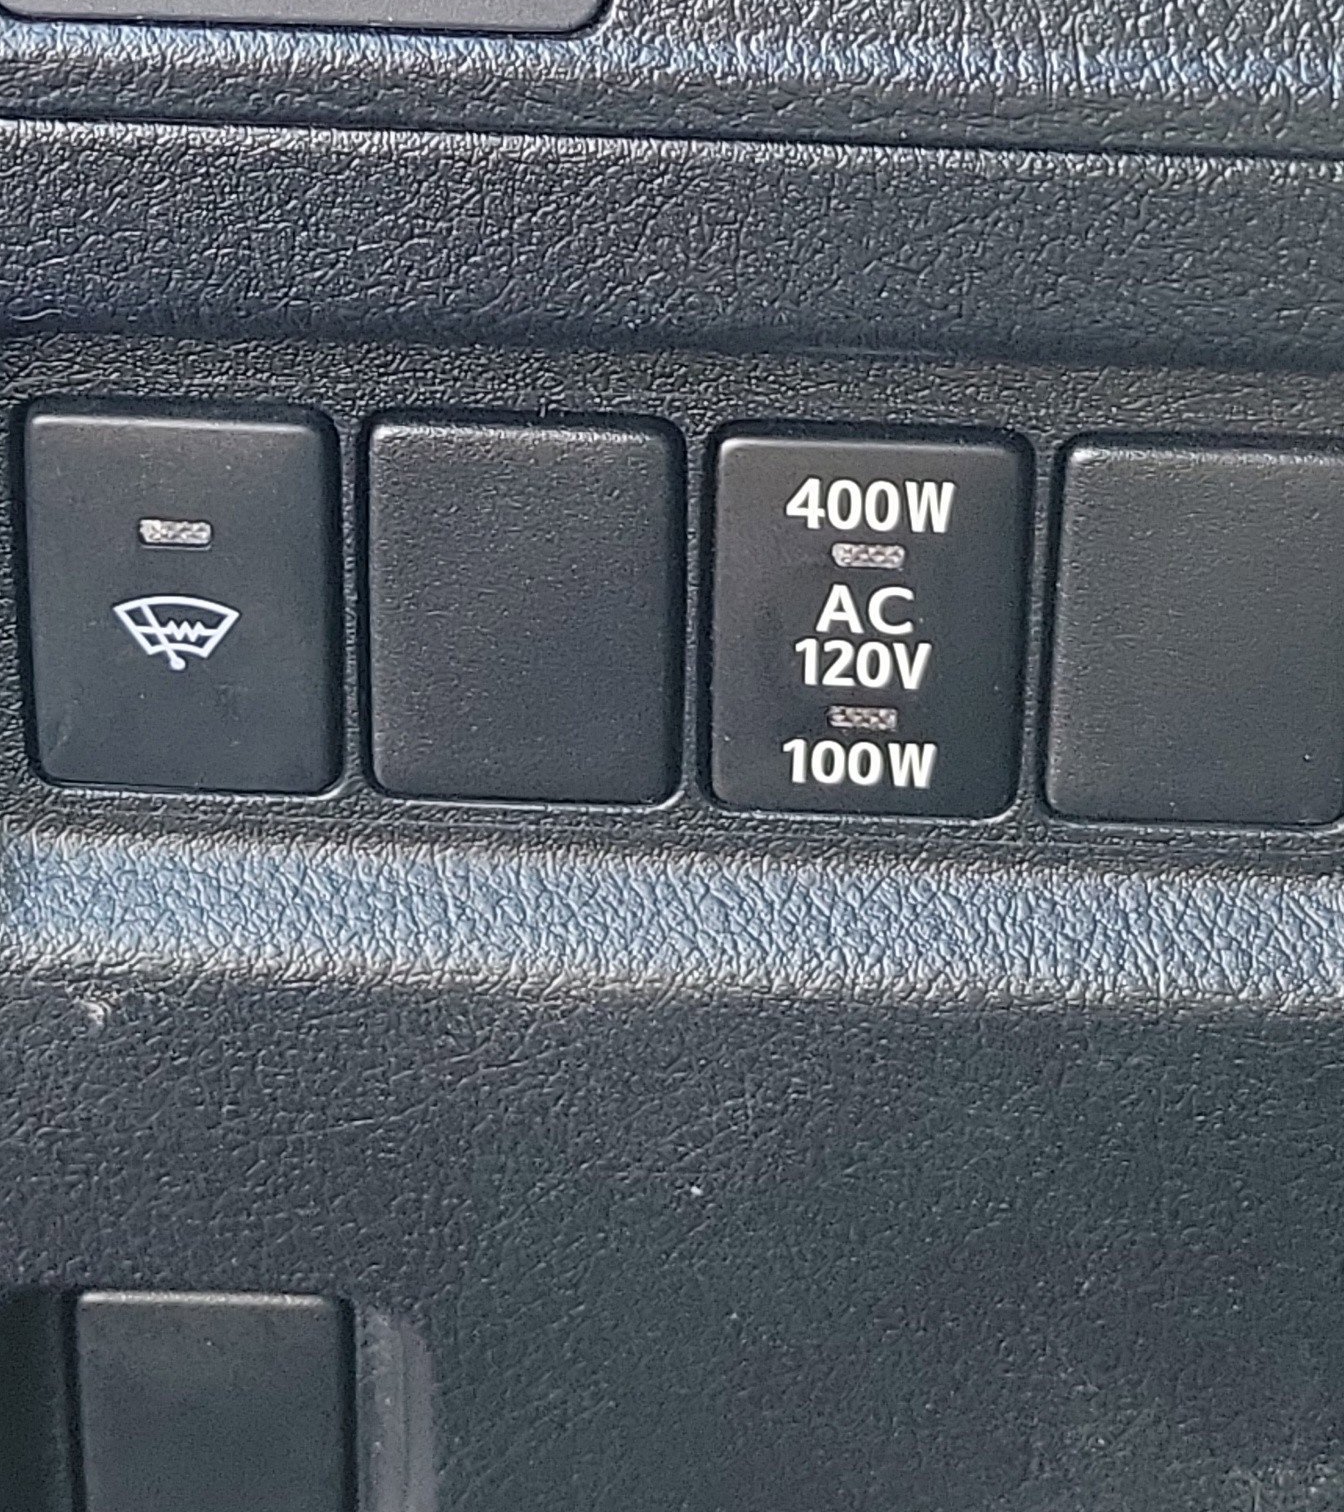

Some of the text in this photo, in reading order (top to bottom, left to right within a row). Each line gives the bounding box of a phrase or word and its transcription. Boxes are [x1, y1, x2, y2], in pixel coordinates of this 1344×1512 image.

[785, 477, 956, 533] 400W
[815, 584, 915, 634] AC
[794, 638, 933, 690] 120V
[781, 738, 938, 788] 100W
